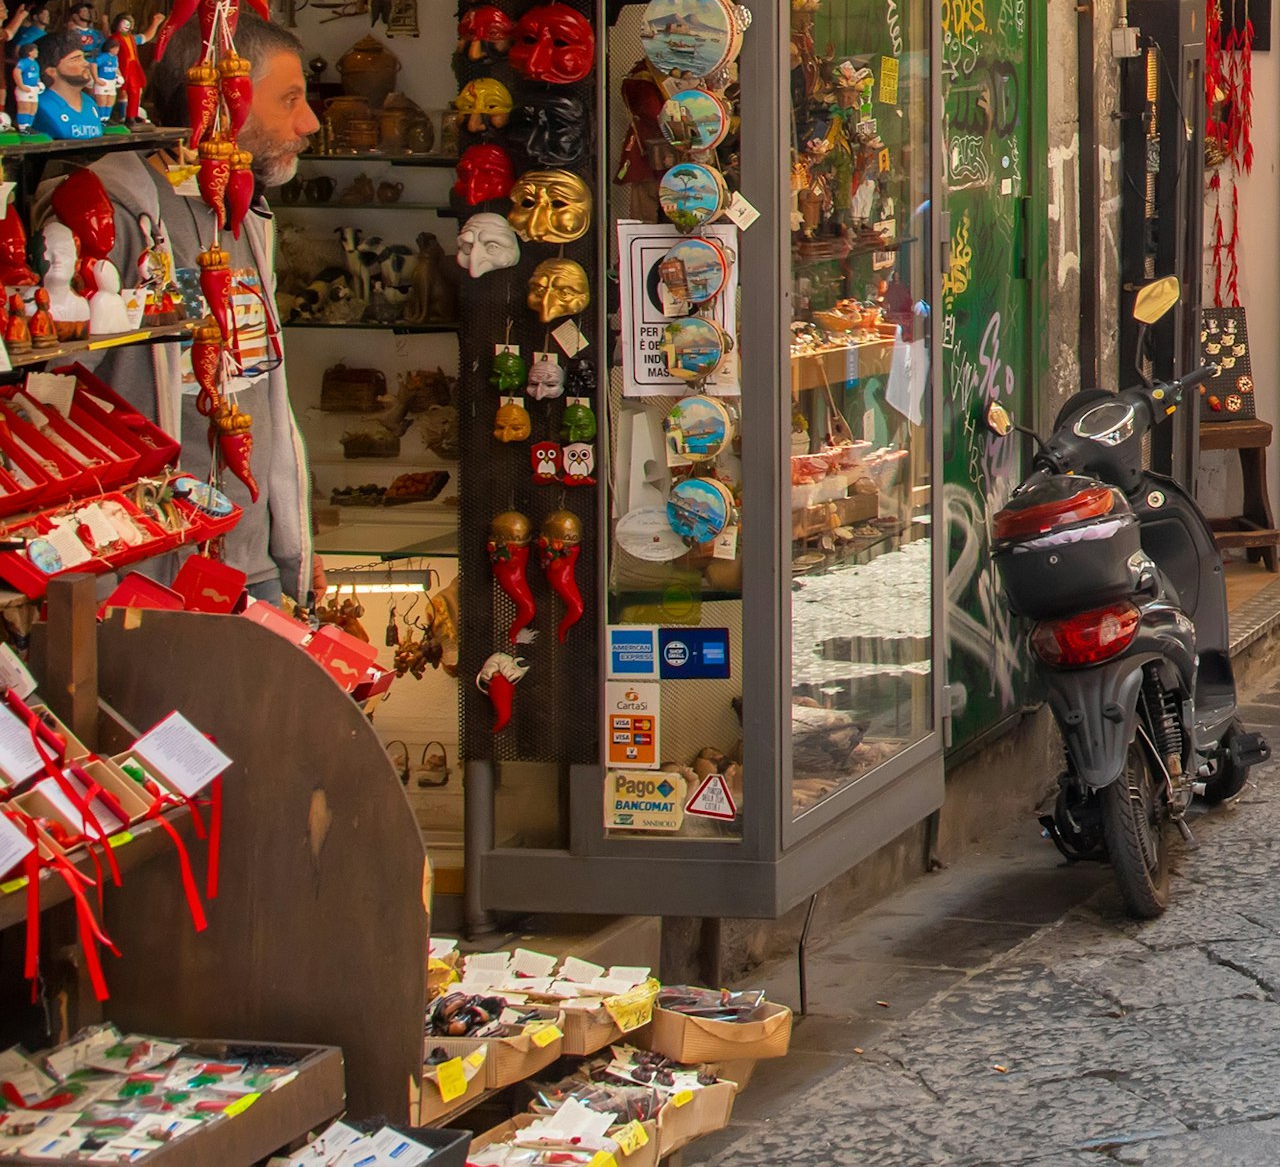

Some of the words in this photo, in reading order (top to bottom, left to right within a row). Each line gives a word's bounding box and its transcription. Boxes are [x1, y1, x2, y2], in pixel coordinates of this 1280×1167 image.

[640, 327, 659, 337] PER
[640, 338, 646, 350] È
[616, 701, 648, 711] CartaSi
[615, 775, 656, 798] Pago
[615, 800, 676, 812] BANCOMAT
